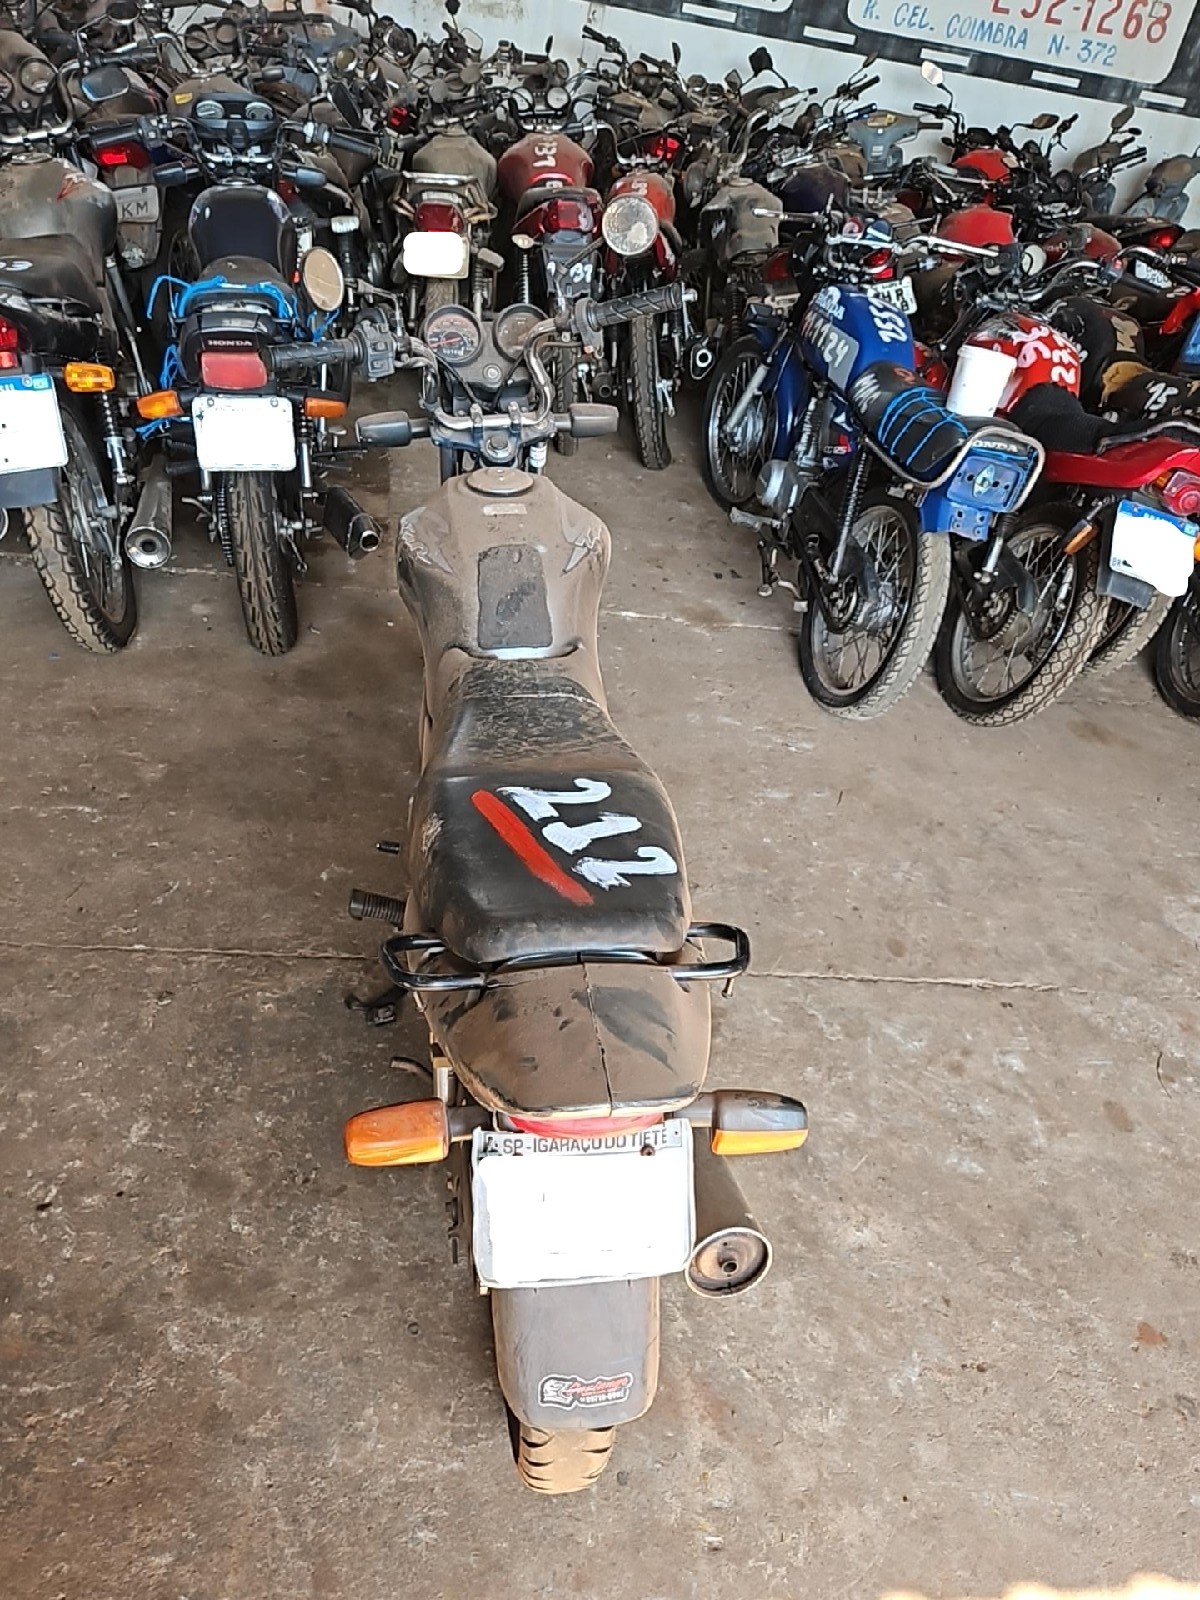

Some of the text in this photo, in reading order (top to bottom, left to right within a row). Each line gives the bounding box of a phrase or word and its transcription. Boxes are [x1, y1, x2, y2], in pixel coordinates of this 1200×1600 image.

[894, 2, 935, 31] CEL.
[946, 13, 1029, 50] COIMBRA
[1076, 39, 1118, 67] 372
